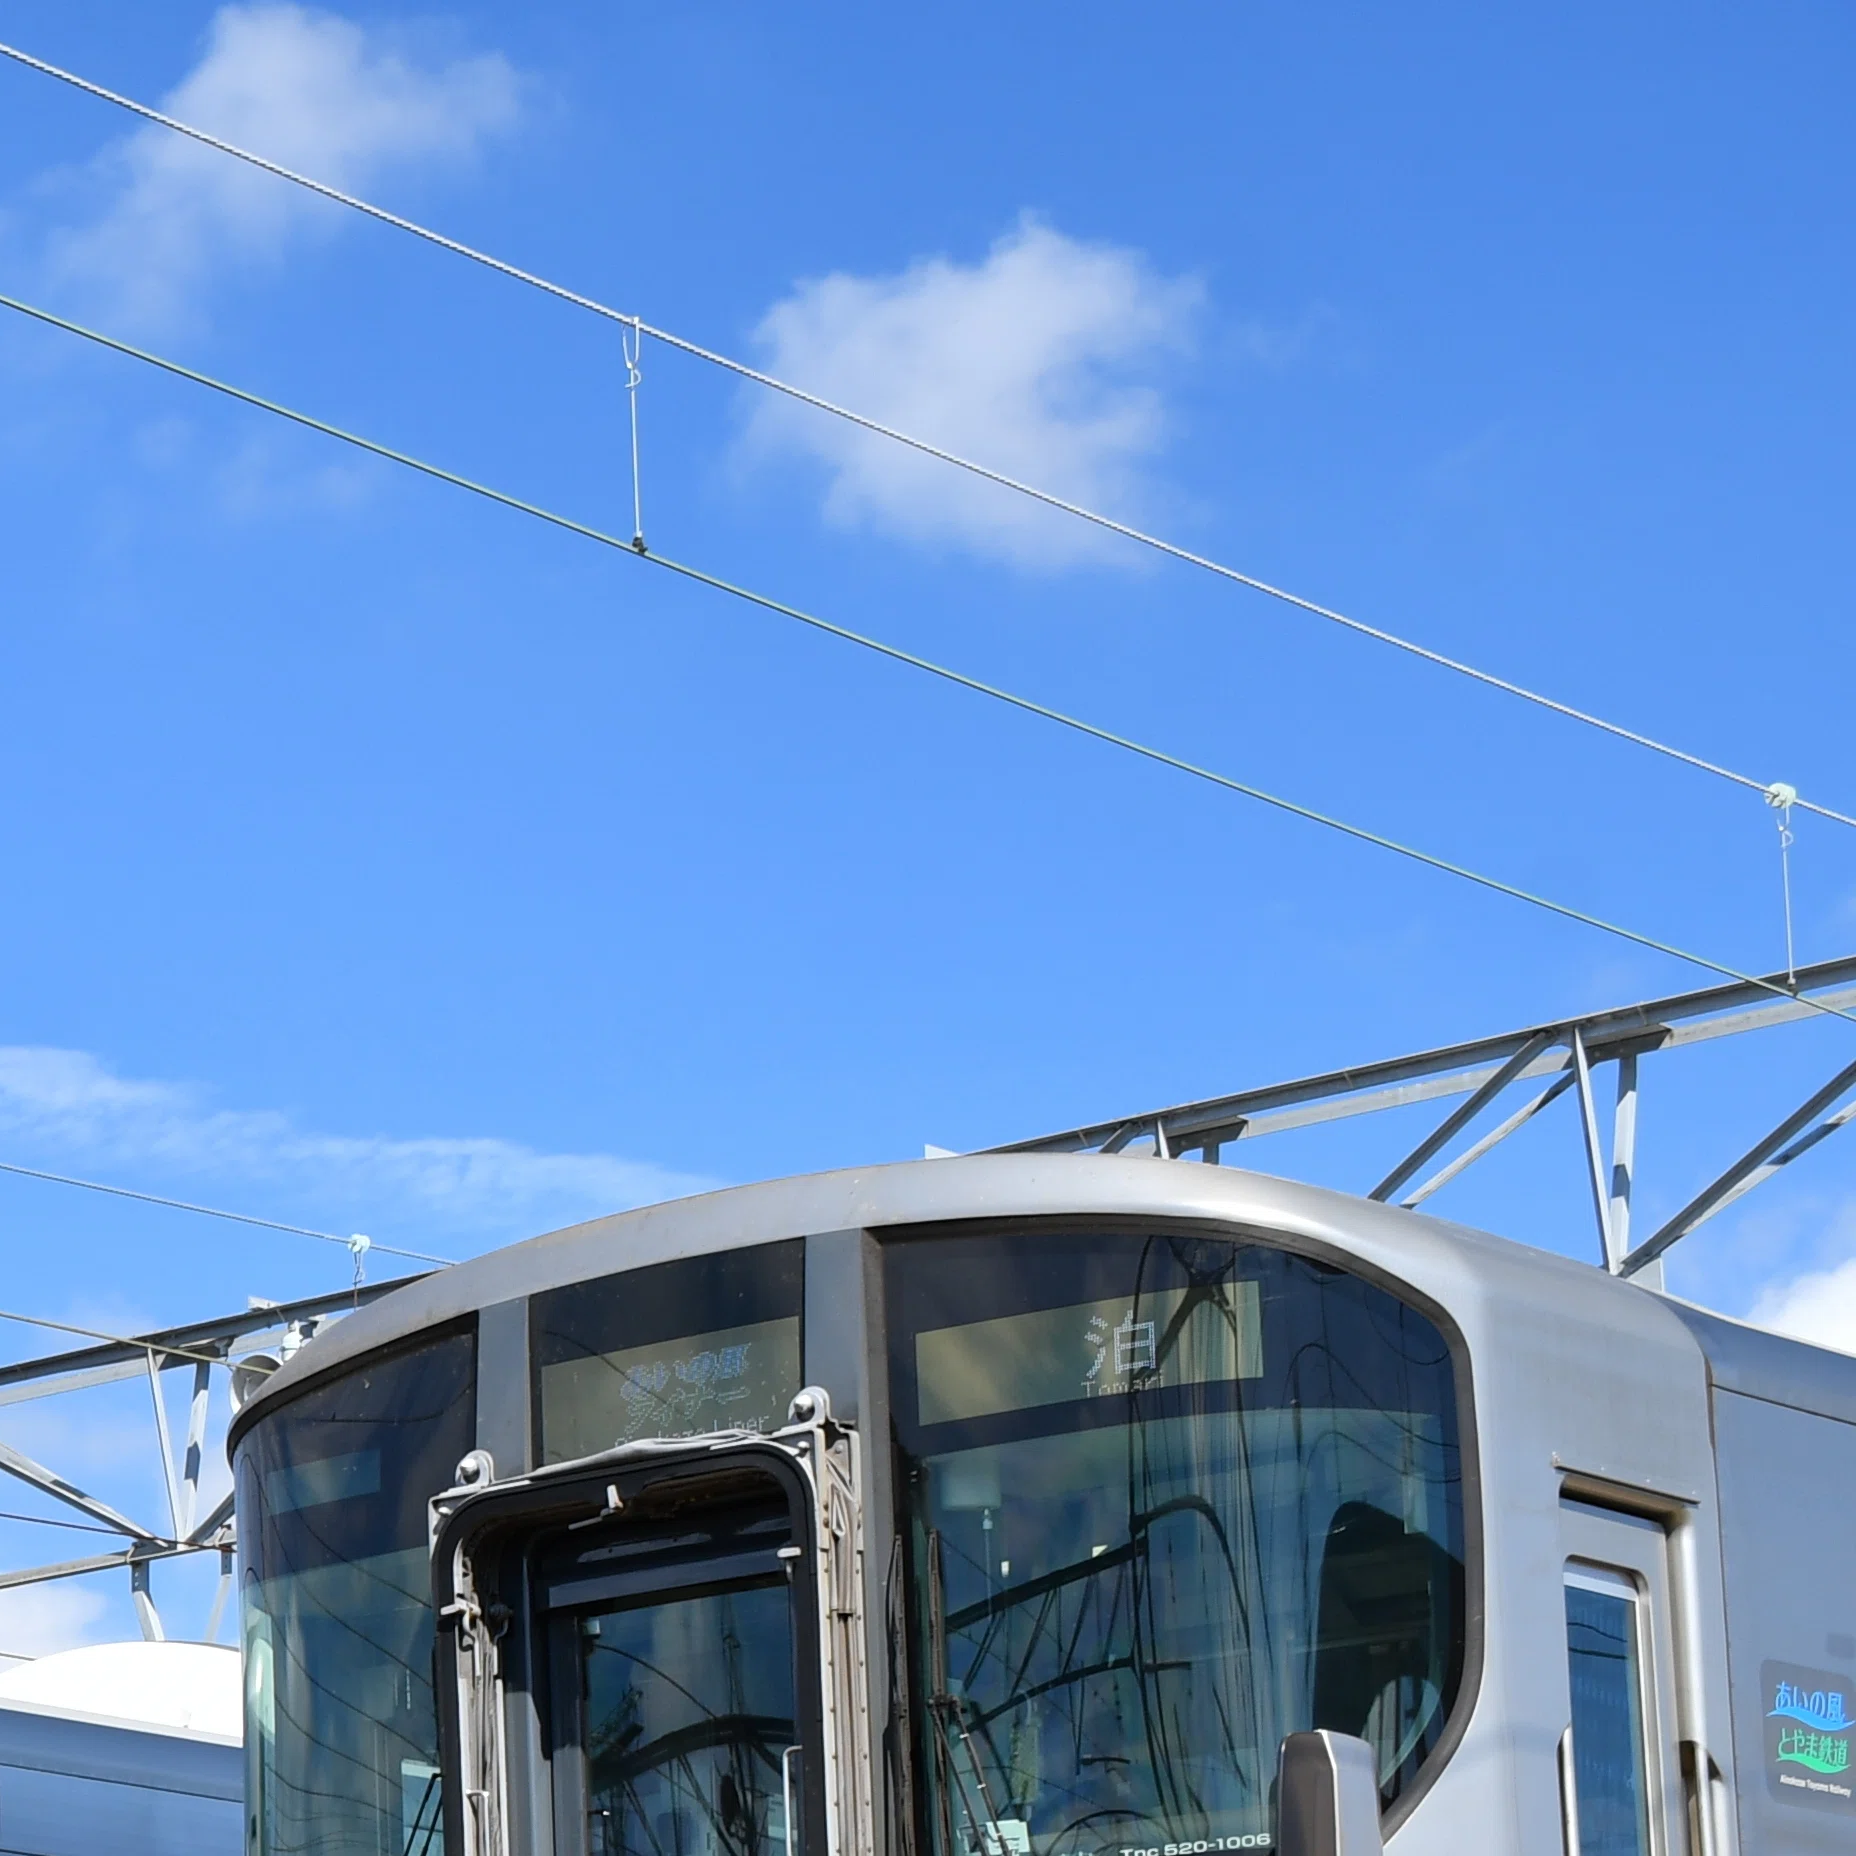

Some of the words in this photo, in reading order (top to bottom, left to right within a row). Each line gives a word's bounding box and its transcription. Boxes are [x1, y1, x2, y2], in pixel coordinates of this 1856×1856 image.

[1084, 1309, 1156, 1379] 泊
[1081, 1369, 1164, 1398] Tomari
[1775, 1681, 1847, 1724] あいの風
[1778, 1728, 1849, 1767] とやま鉄道
[1163, 1833, 1271, 1856] 520-1006
